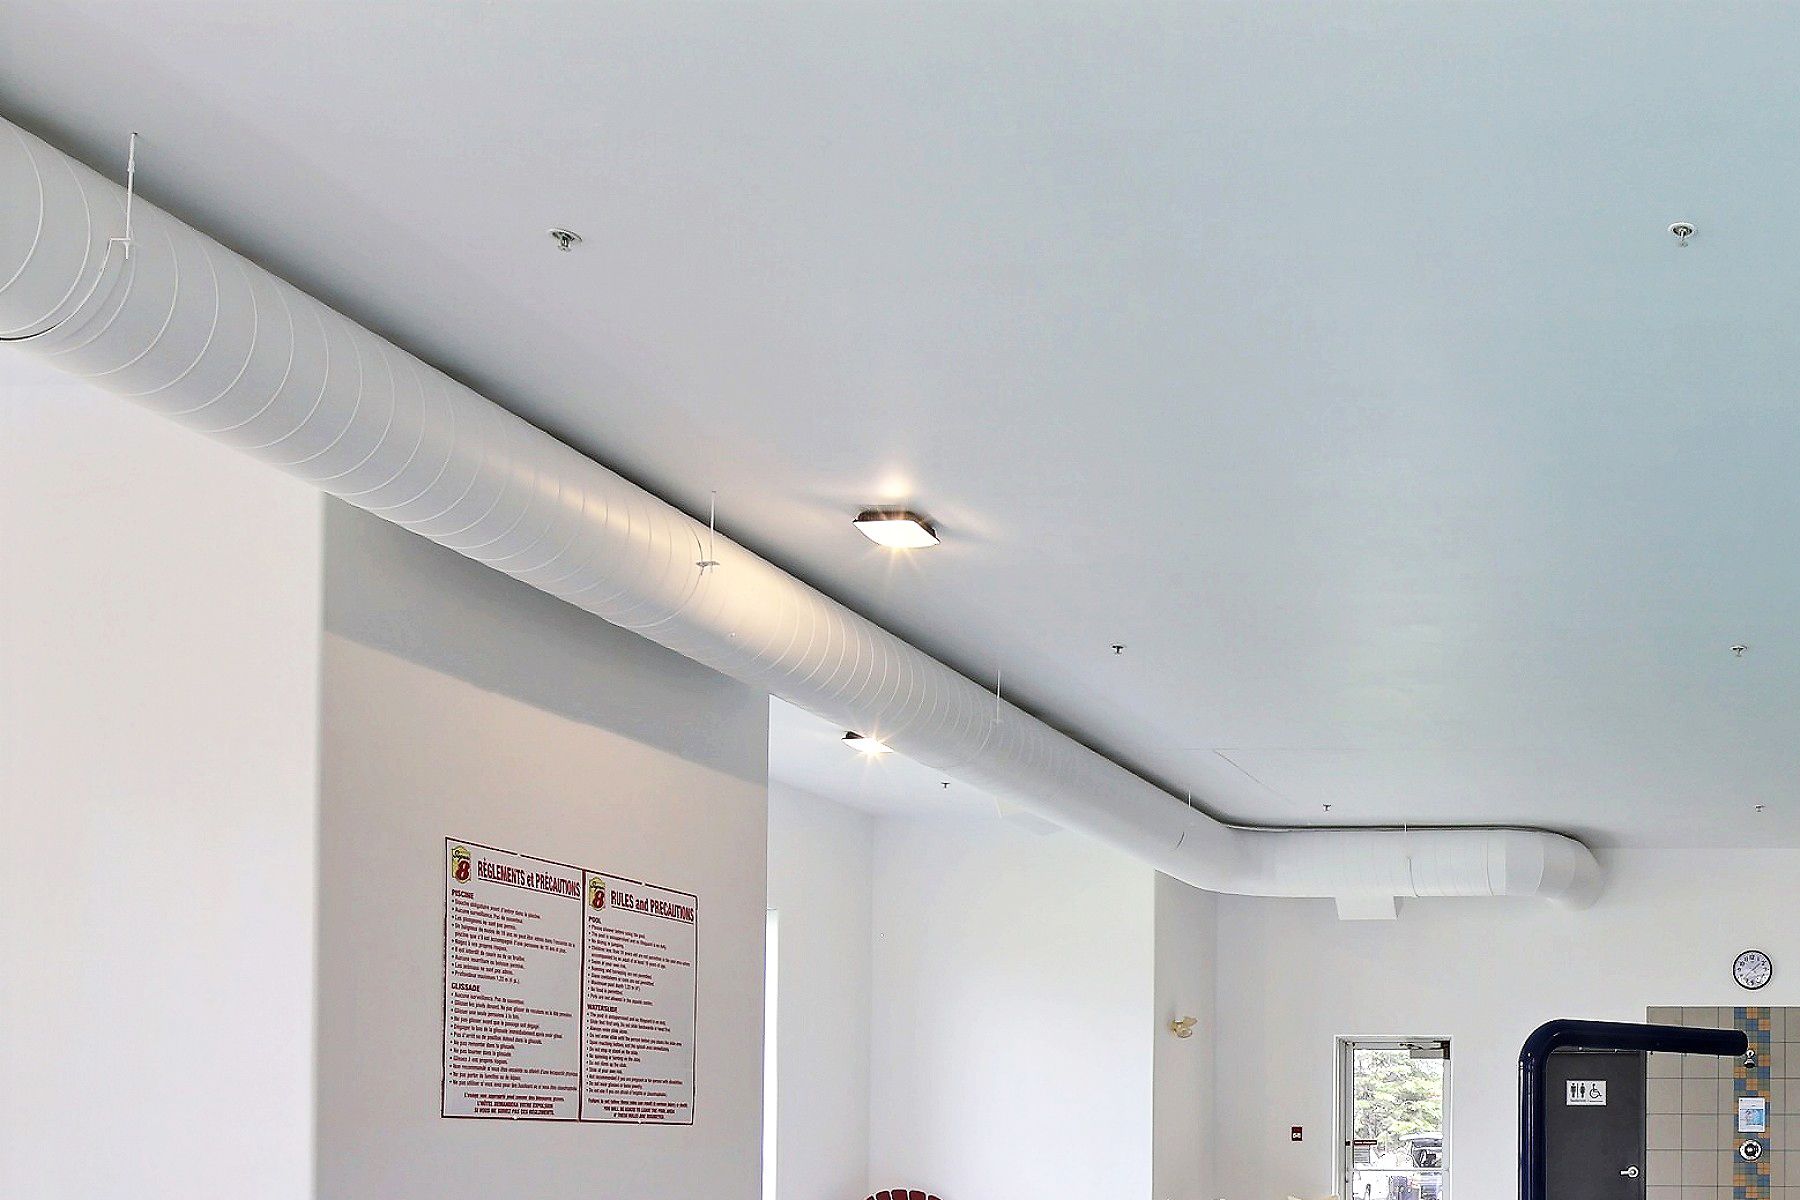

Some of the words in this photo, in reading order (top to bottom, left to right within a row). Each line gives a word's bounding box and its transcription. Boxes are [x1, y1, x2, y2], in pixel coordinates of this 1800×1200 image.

[456, 860, 470, 880] 8
[451, 889, 475, 899] PISCINE
[526, 873, 535, 888] et
[535, 872, 581, 898] PRÉCAUTIONS
[593, 891, 605, 909] 8
[610, 890, 634, 909] RULES
[634, 898, 649, 912] and
[649, 899, 695, 922] PRECAUTIONS
[588, 916, 602, 924] POOL
[451, 983, 480, 993] GLISSADE
